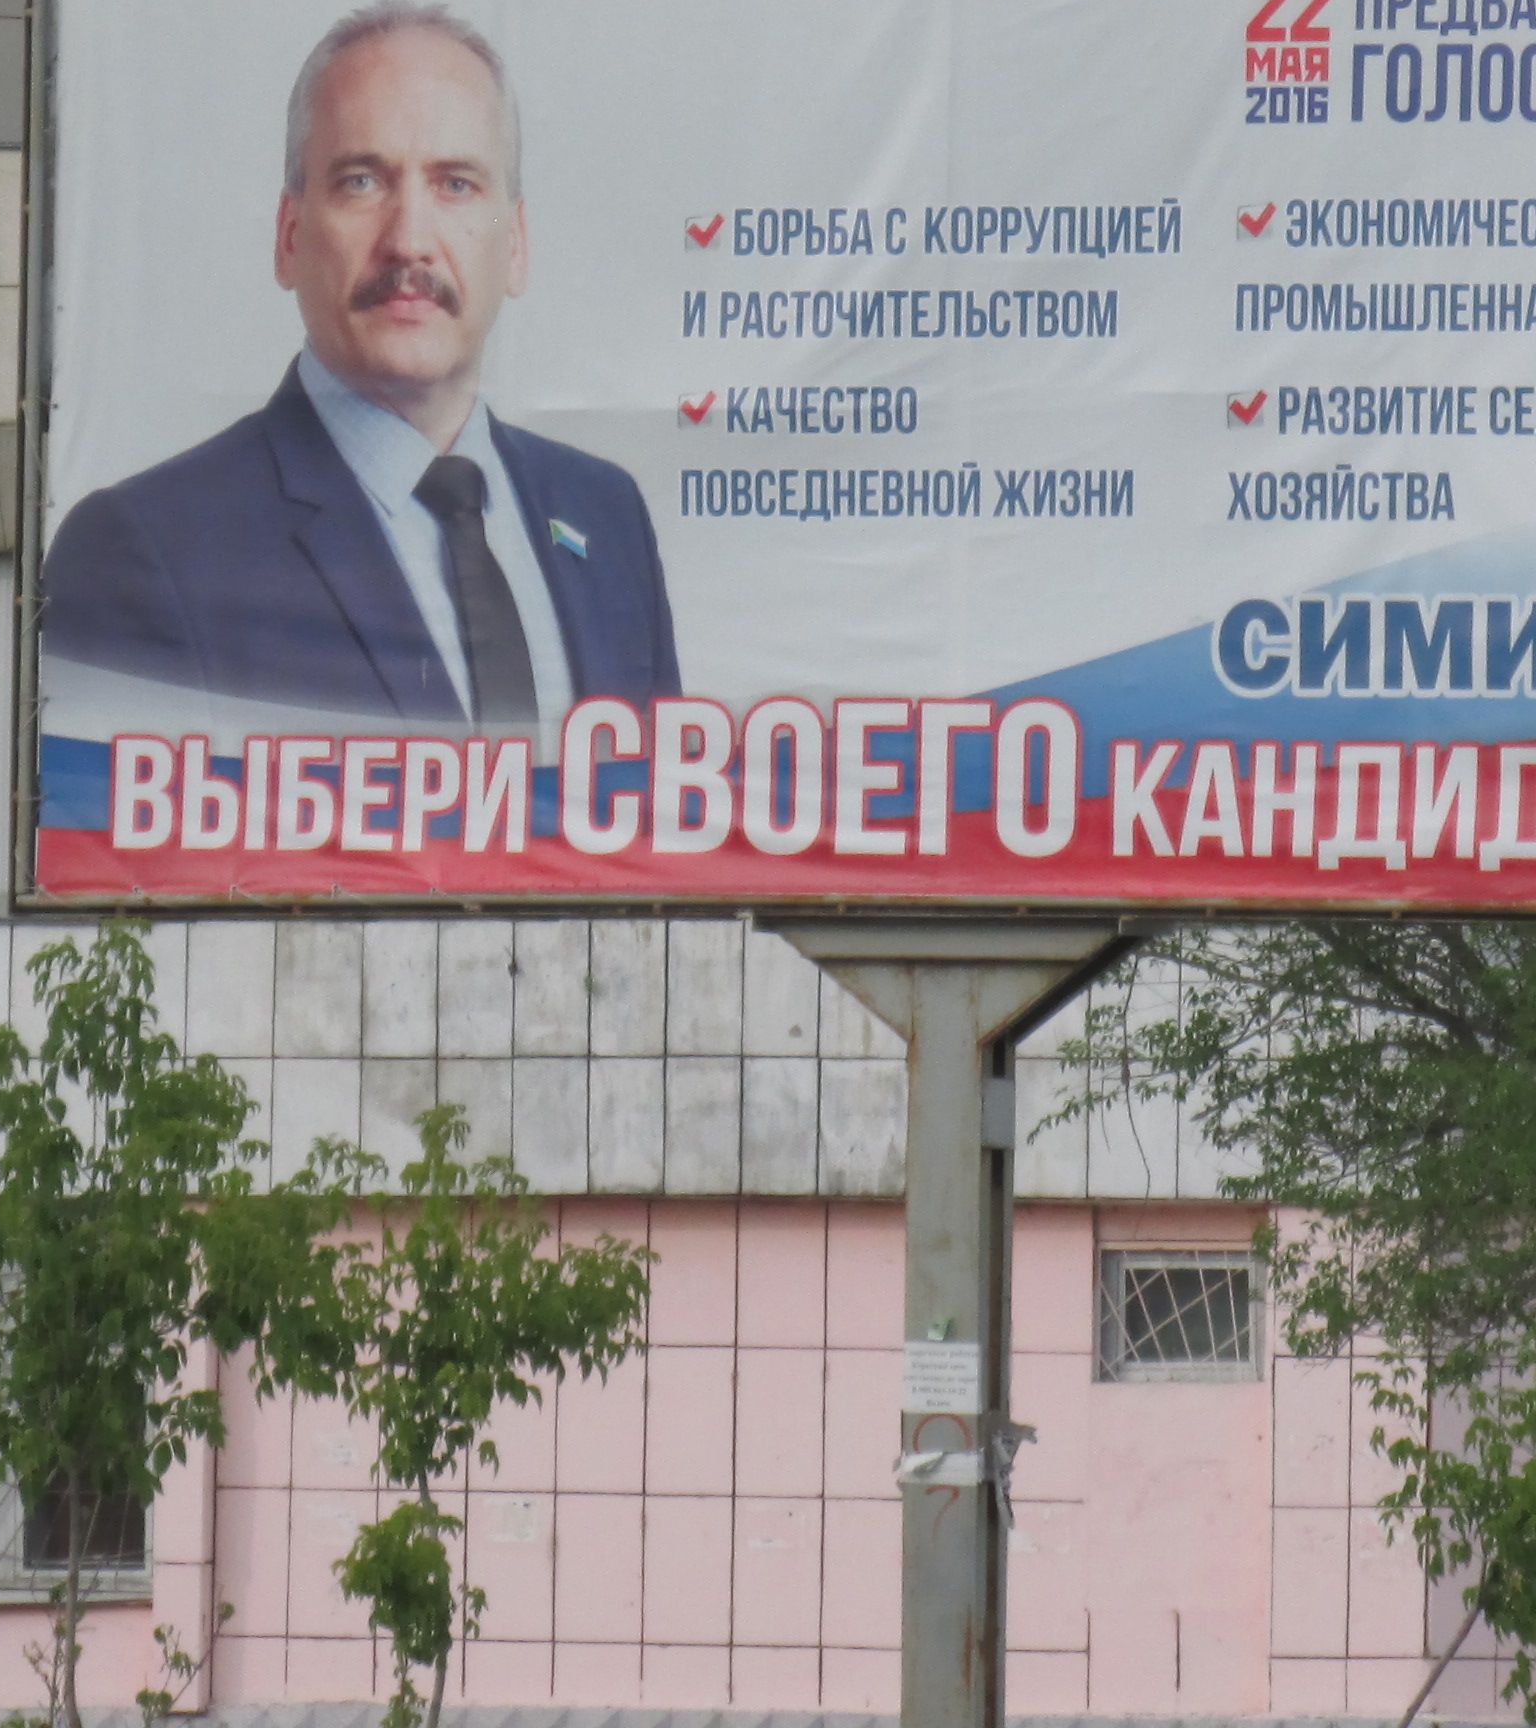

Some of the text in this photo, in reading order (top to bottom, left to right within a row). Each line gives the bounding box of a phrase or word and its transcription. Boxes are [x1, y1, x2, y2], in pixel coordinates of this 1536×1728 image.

[1245, 47, 1329, 83] МАЯ
[1245, 86, 1329, 125] 2016
[734, 198, 1182, 259] БОРЬБА С КОРРУПЦИЕЙ
[683, 289, 1119, 339] И РАСТОЧИТЕЛЬСТВОМ
[727, 386, 917, 435] КАЧЕСТВО
[1277, 386, 1477, 436] РАЗВИТИЕ
[681, 462, 1135, 522] ПОВСЕДНЕВНОЙ ЖИЗНИ
[1227, 462, 1455, 522] ХОЗЯЙСТВА
[114, 736, 530, 853] ВЫБЕРИ
[560, 699, 1079, 859] СВОЕГО
